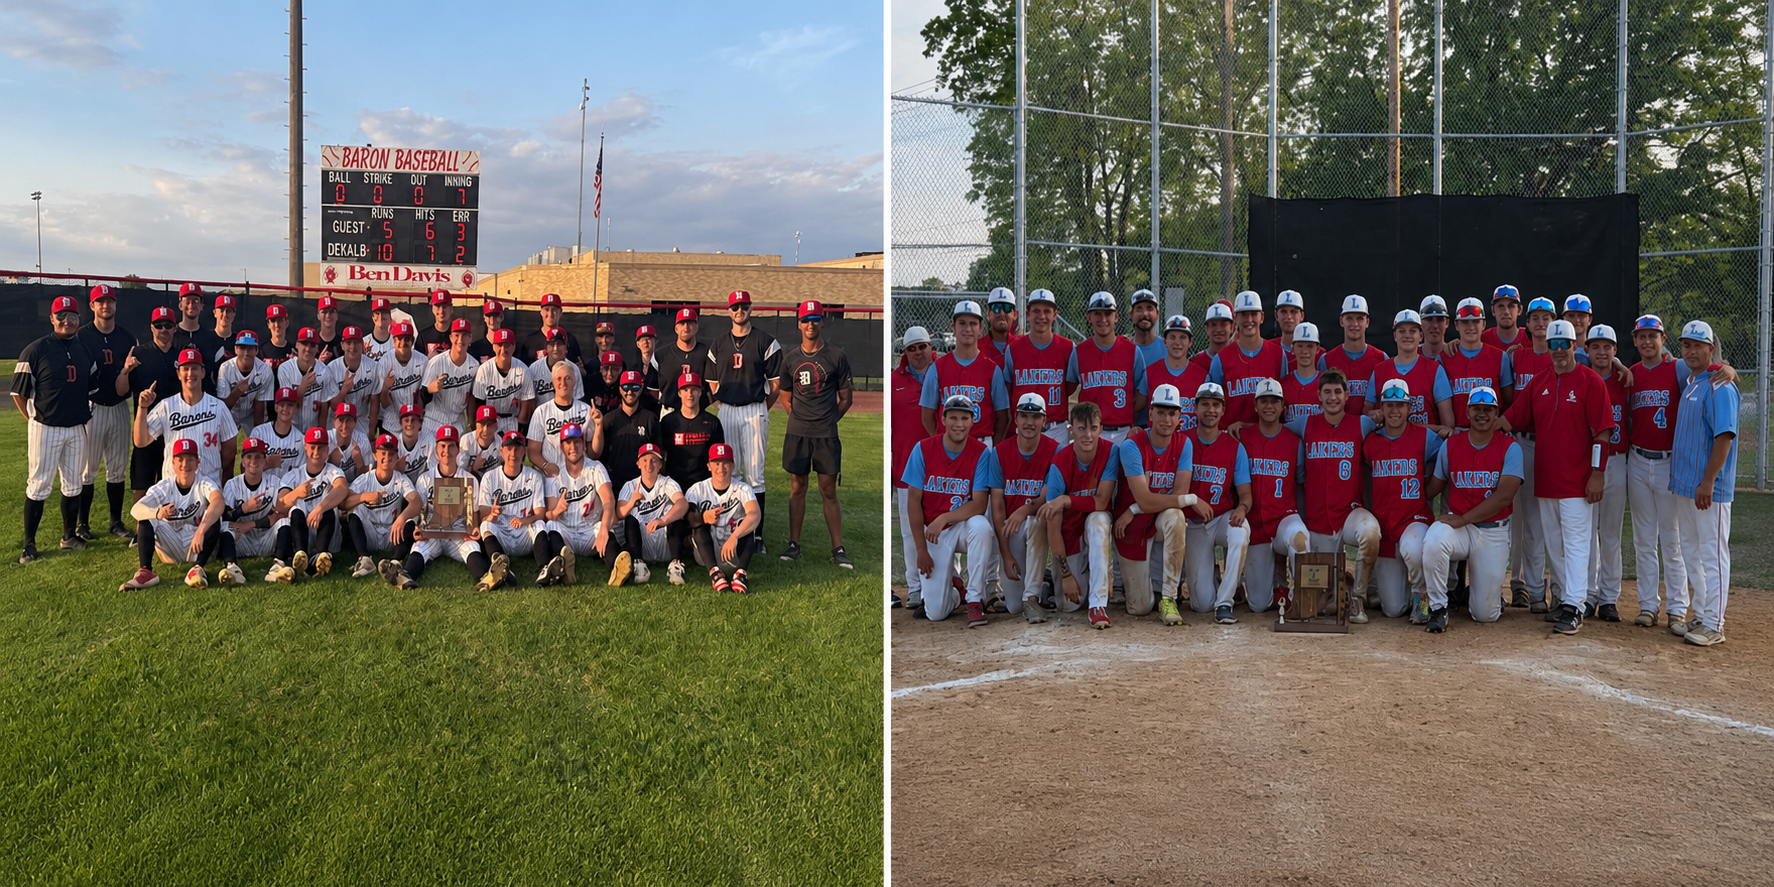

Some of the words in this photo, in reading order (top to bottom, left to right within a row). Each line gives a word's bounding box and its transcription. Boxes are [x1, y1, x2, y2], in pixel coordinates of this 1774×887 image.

[342, 146, 390, 169] BARON
[395, 149, 459, 172] BASEBALL
[329, 172, 351, 184] BALL
[363, 173, 393, 185] STRIKE
[410, 174, 427, 186] OUT
[444, 176, 472, 188] INNING
[335, 184, 345, 202] 0
[373, 185, 383, 204] 0
[414, 186, 424, 205] 0
[458, 188, 465, 205] 7
[371, 207, 394, 220] RUNS
[415, 209, 435, 221] HITS
[452, 211, 470, 223] ERR
[332, 220, 365, 234] GUEST
[383, 221, 393, 239] 5
[425, 221, 435, 240] 6
[457, 223, 465, 242] 3
[327, 242, 367, 257] DEKALB
[377, 243, 393, 261] 10
[427, 245, 435, 261] 7
[456, 245, 465, 263] 2
[349, 264, 393, 281] Ben
[393, 267, 451, 283] Davis
[998, 289, 1007, 299] L
[1244, 294, 1253, 306] L
[1286, 292, 1293, 303] L
[1352, 297, 1359, 309] L
[1302, 326, 1310, 338] L
[1554, 323, 1563, 336] L
[102, 349, 113, 365] D
[733, 353, 743, 369] D
[66, 365, 77, 382] D
[1014, 368, 1064, 386] LAKERS
[1081, 369, 1127, 389] LAKERS
[1048, 386, 1061, 406] 11
[1113, 388, 1126, 408] 3
[1164, 388, 1173, 401] L
[169, 410, 217, 431] Barons
[1653, 407, 1667, 428] 4
[203, 431, 218, 448] 34
[1306, 441, 1354, 459] LAKERS
[1339, 460, 1351, 480] 6
[1372, 458, 1418, 477] LAKERS
[1274, 478, 1283, 498] 1
[1400, 478, 1420, 499] 12
[1450, 471, 1499, 489] LAKERS
